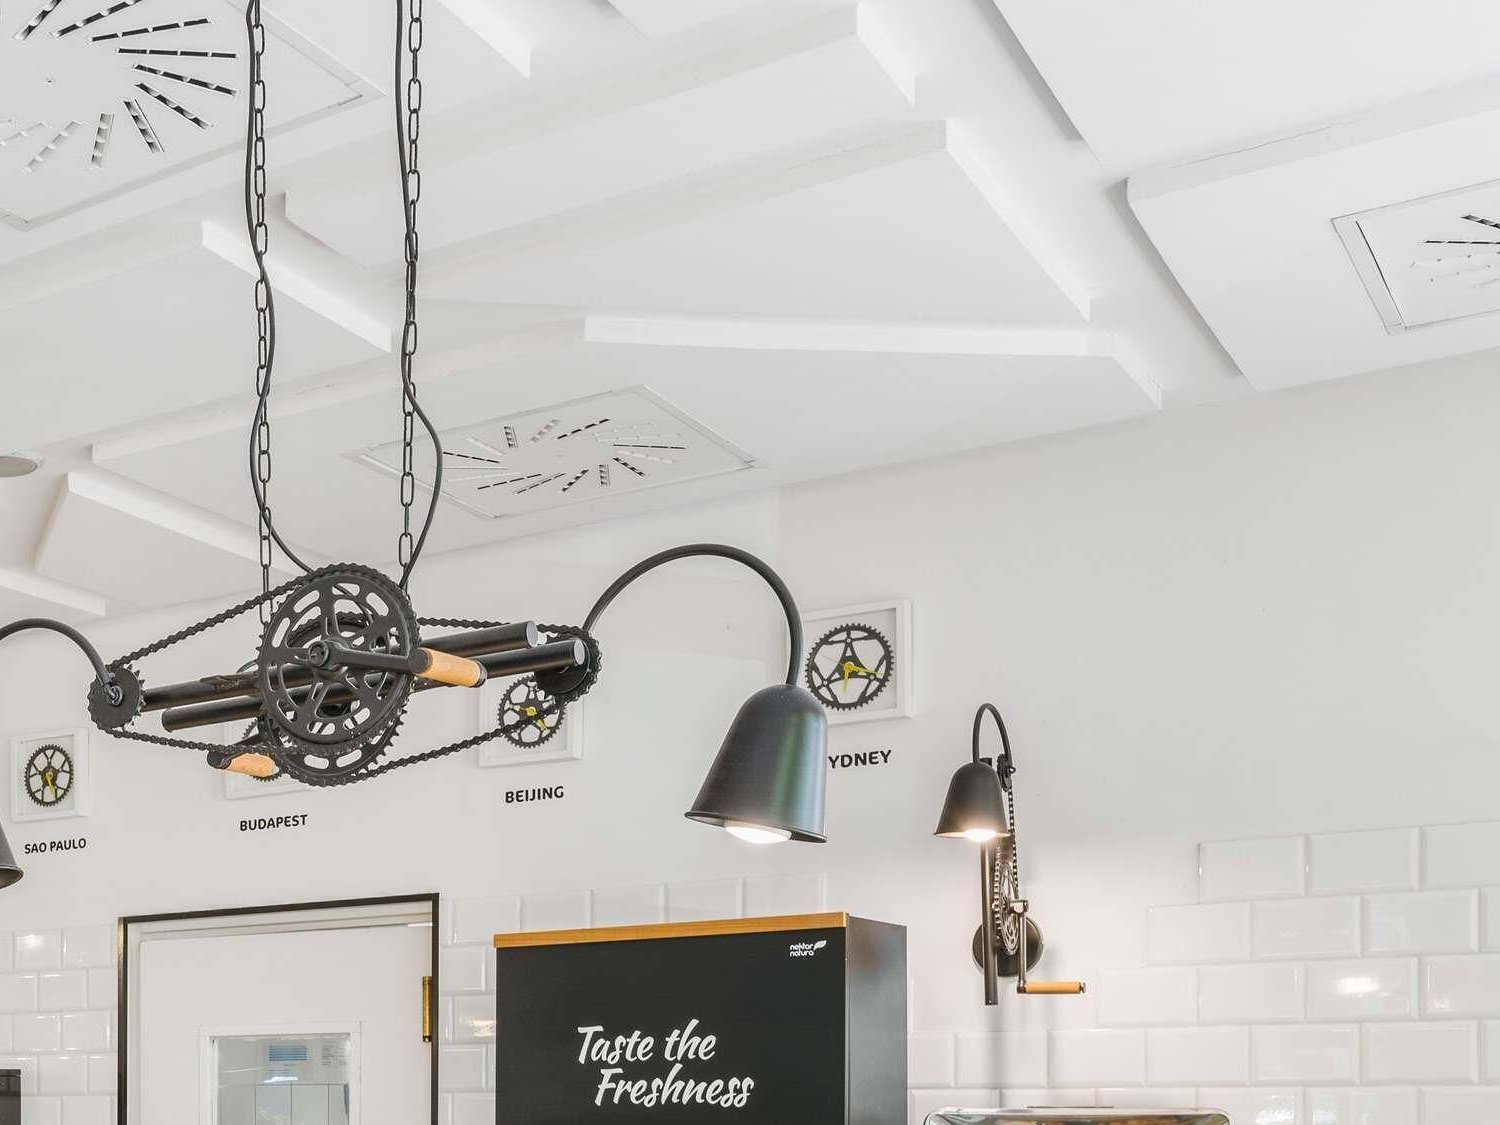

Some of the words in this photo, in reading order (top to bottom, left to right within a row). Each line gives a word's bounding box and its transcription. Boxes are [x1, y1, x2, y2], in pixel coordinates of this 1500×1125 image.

[828, 749, 892, 769] YDNEY
[505, 786, 565, 803] BEIJING
[239, 814, 308, 831] BUDAPEST
[24, 843, 47, 854] SAO
[49, 837, 87, 852] PAULO
[577, 1025, 655, 1064] Taste
[664, 1018, 717, 1061] the
[594, 1063, 755, 1108] Freshness
